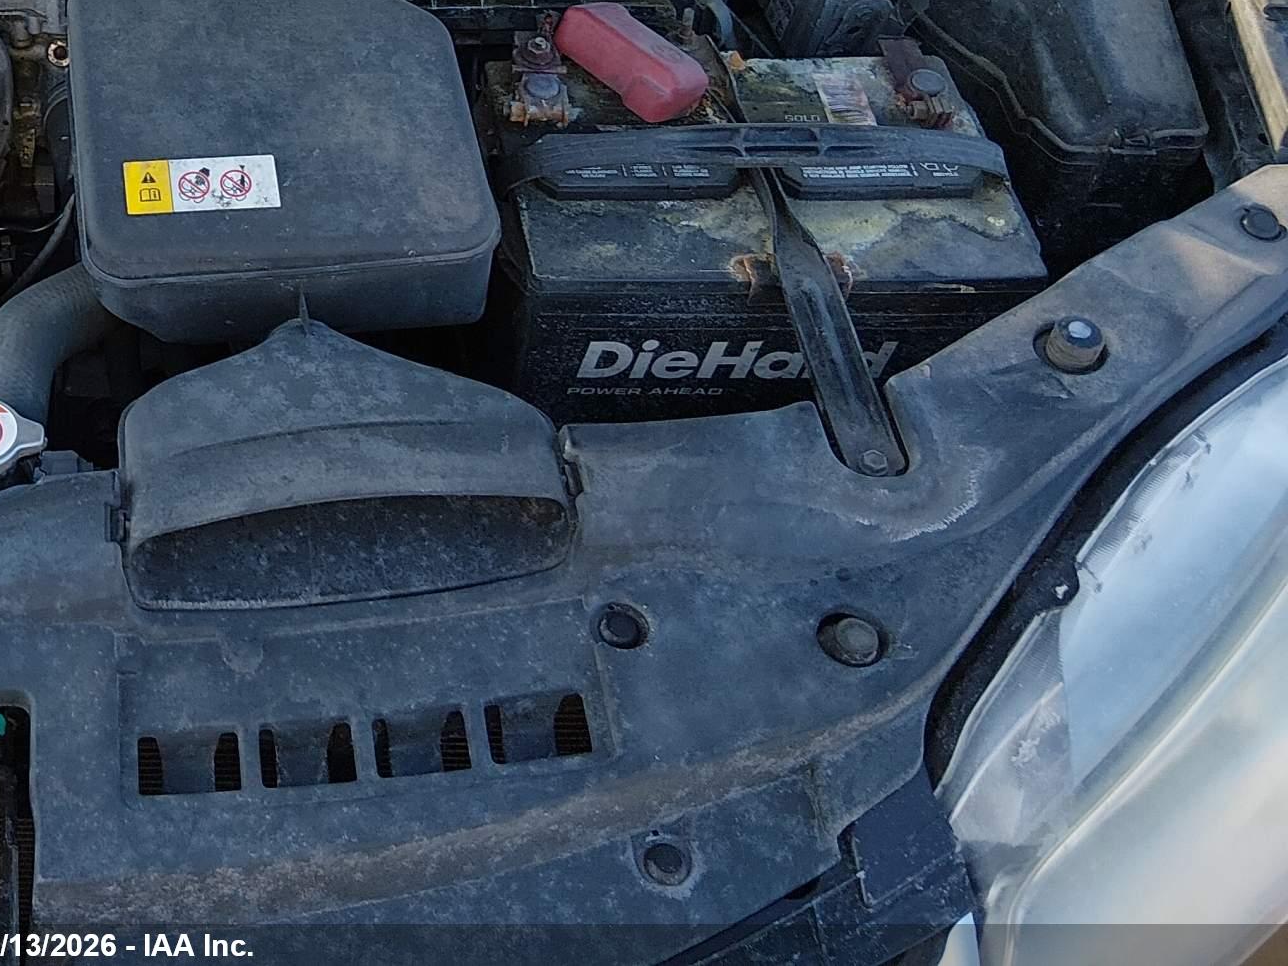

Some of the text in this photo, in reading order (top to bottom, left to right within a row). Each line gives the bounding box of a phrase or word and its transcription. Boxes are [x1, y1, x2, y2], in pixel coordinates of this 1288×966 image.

[576, 339, 899, 380] DieHad
[566, 386, 724, 396] POWER AHEAD
